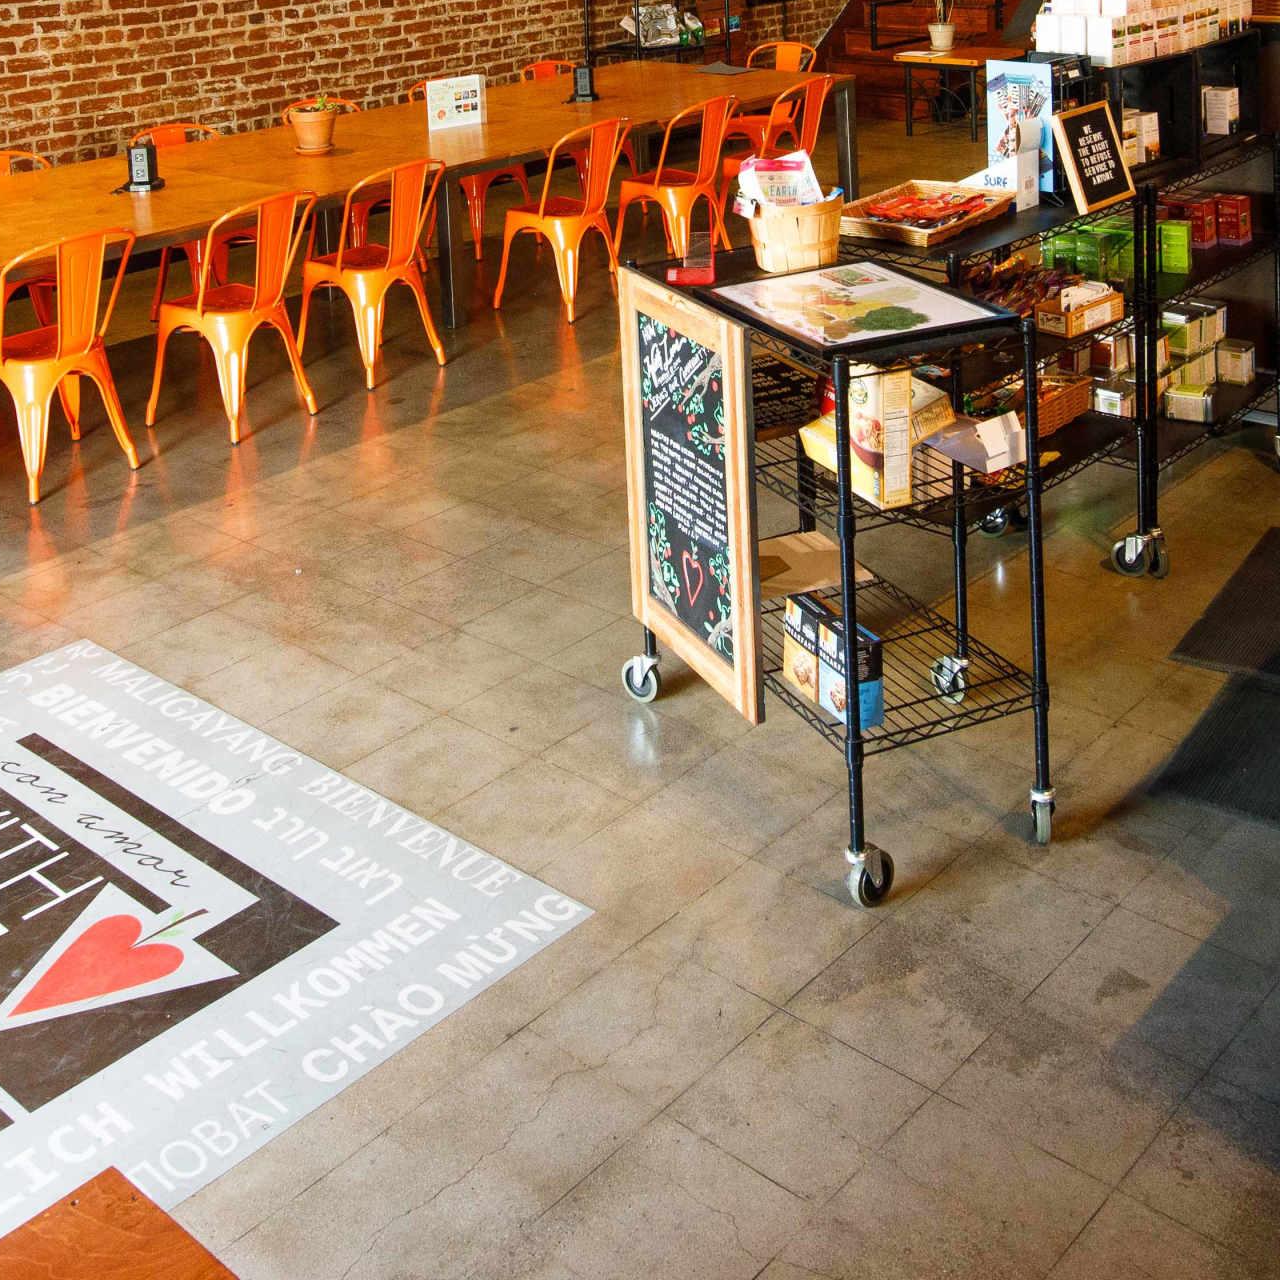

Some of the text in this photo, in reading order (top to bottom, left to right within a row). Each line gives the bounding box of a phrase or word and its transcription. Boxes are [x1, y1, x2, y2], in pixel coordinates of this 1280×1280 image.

[1078, 131, 1104, 146] RESERVE
[1082, 125, 1092, 135] WE
[1078, 140, 1109, 157] THE RIGHT
[1080, 150, 1112, 167] TO REFUSE
[1084, 159, 1115, 177] SERVICE TO
[984, 174, 1007, 188] SURF
[1092, 170, 1114, 185] ANYONE
[820, 649, 845, 674] BREAKFA
[29, 682, 256, 815] BIENVENIDO
[1, 760, 69, 804] con
[92, 660, 522, 898] MALIGAYANG BIENVENUE
[300, 893, 584, 1084] CHÀO MỪNG
[143, 896, 463, 1102] WILLKOMMEN
